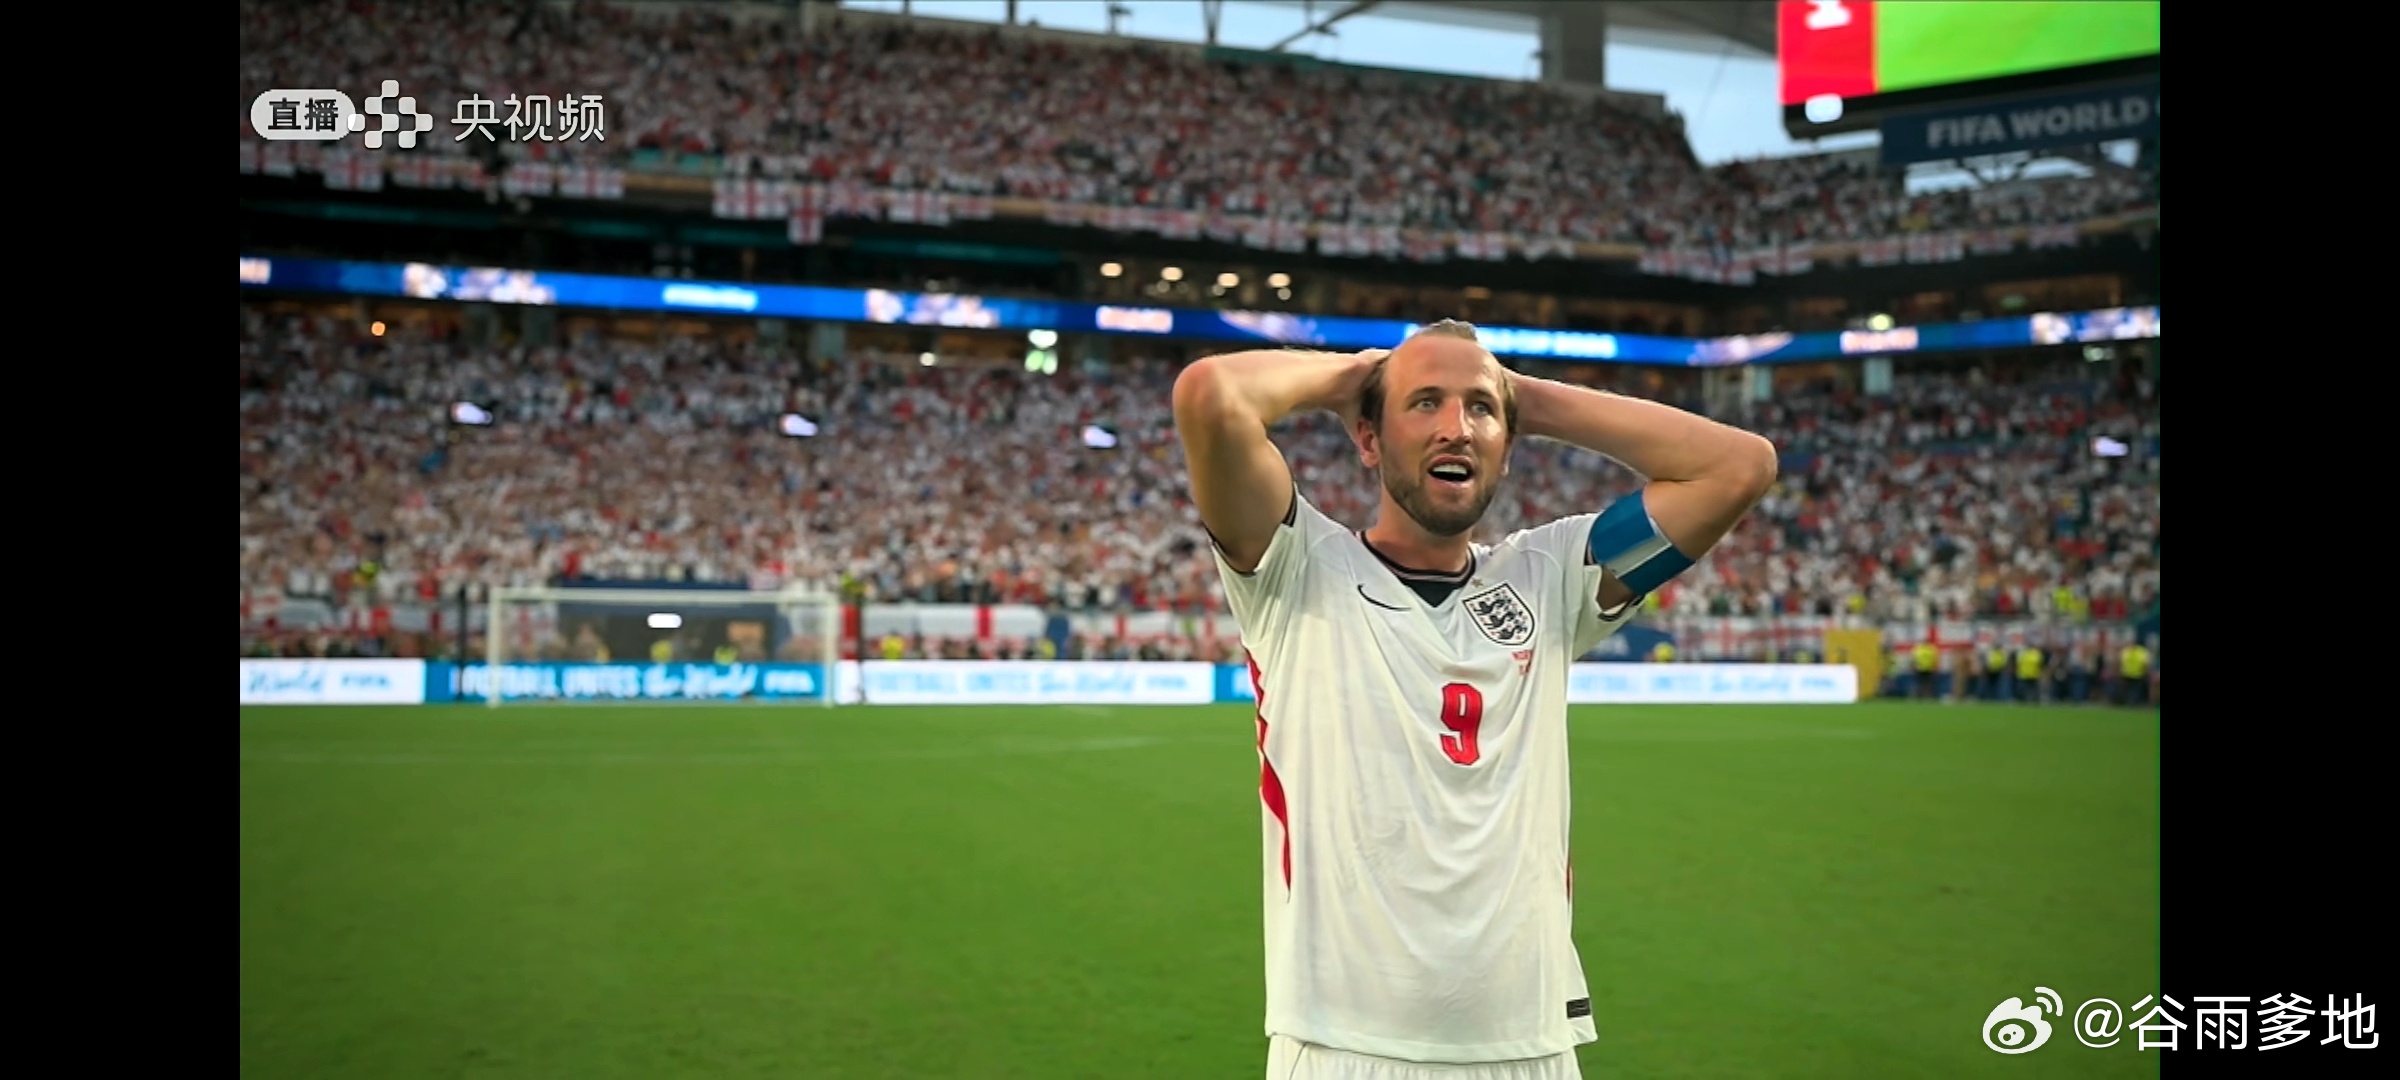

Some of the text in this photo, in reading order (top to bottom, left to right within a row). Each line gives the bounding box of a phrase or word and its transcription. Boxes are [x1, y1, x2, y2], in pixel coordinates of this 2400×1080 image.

[1926, 116, 2006, 149] FIFA
[2010, 97, 2150, 139] WORLD
[1439, 681, 1484, 767] 9
